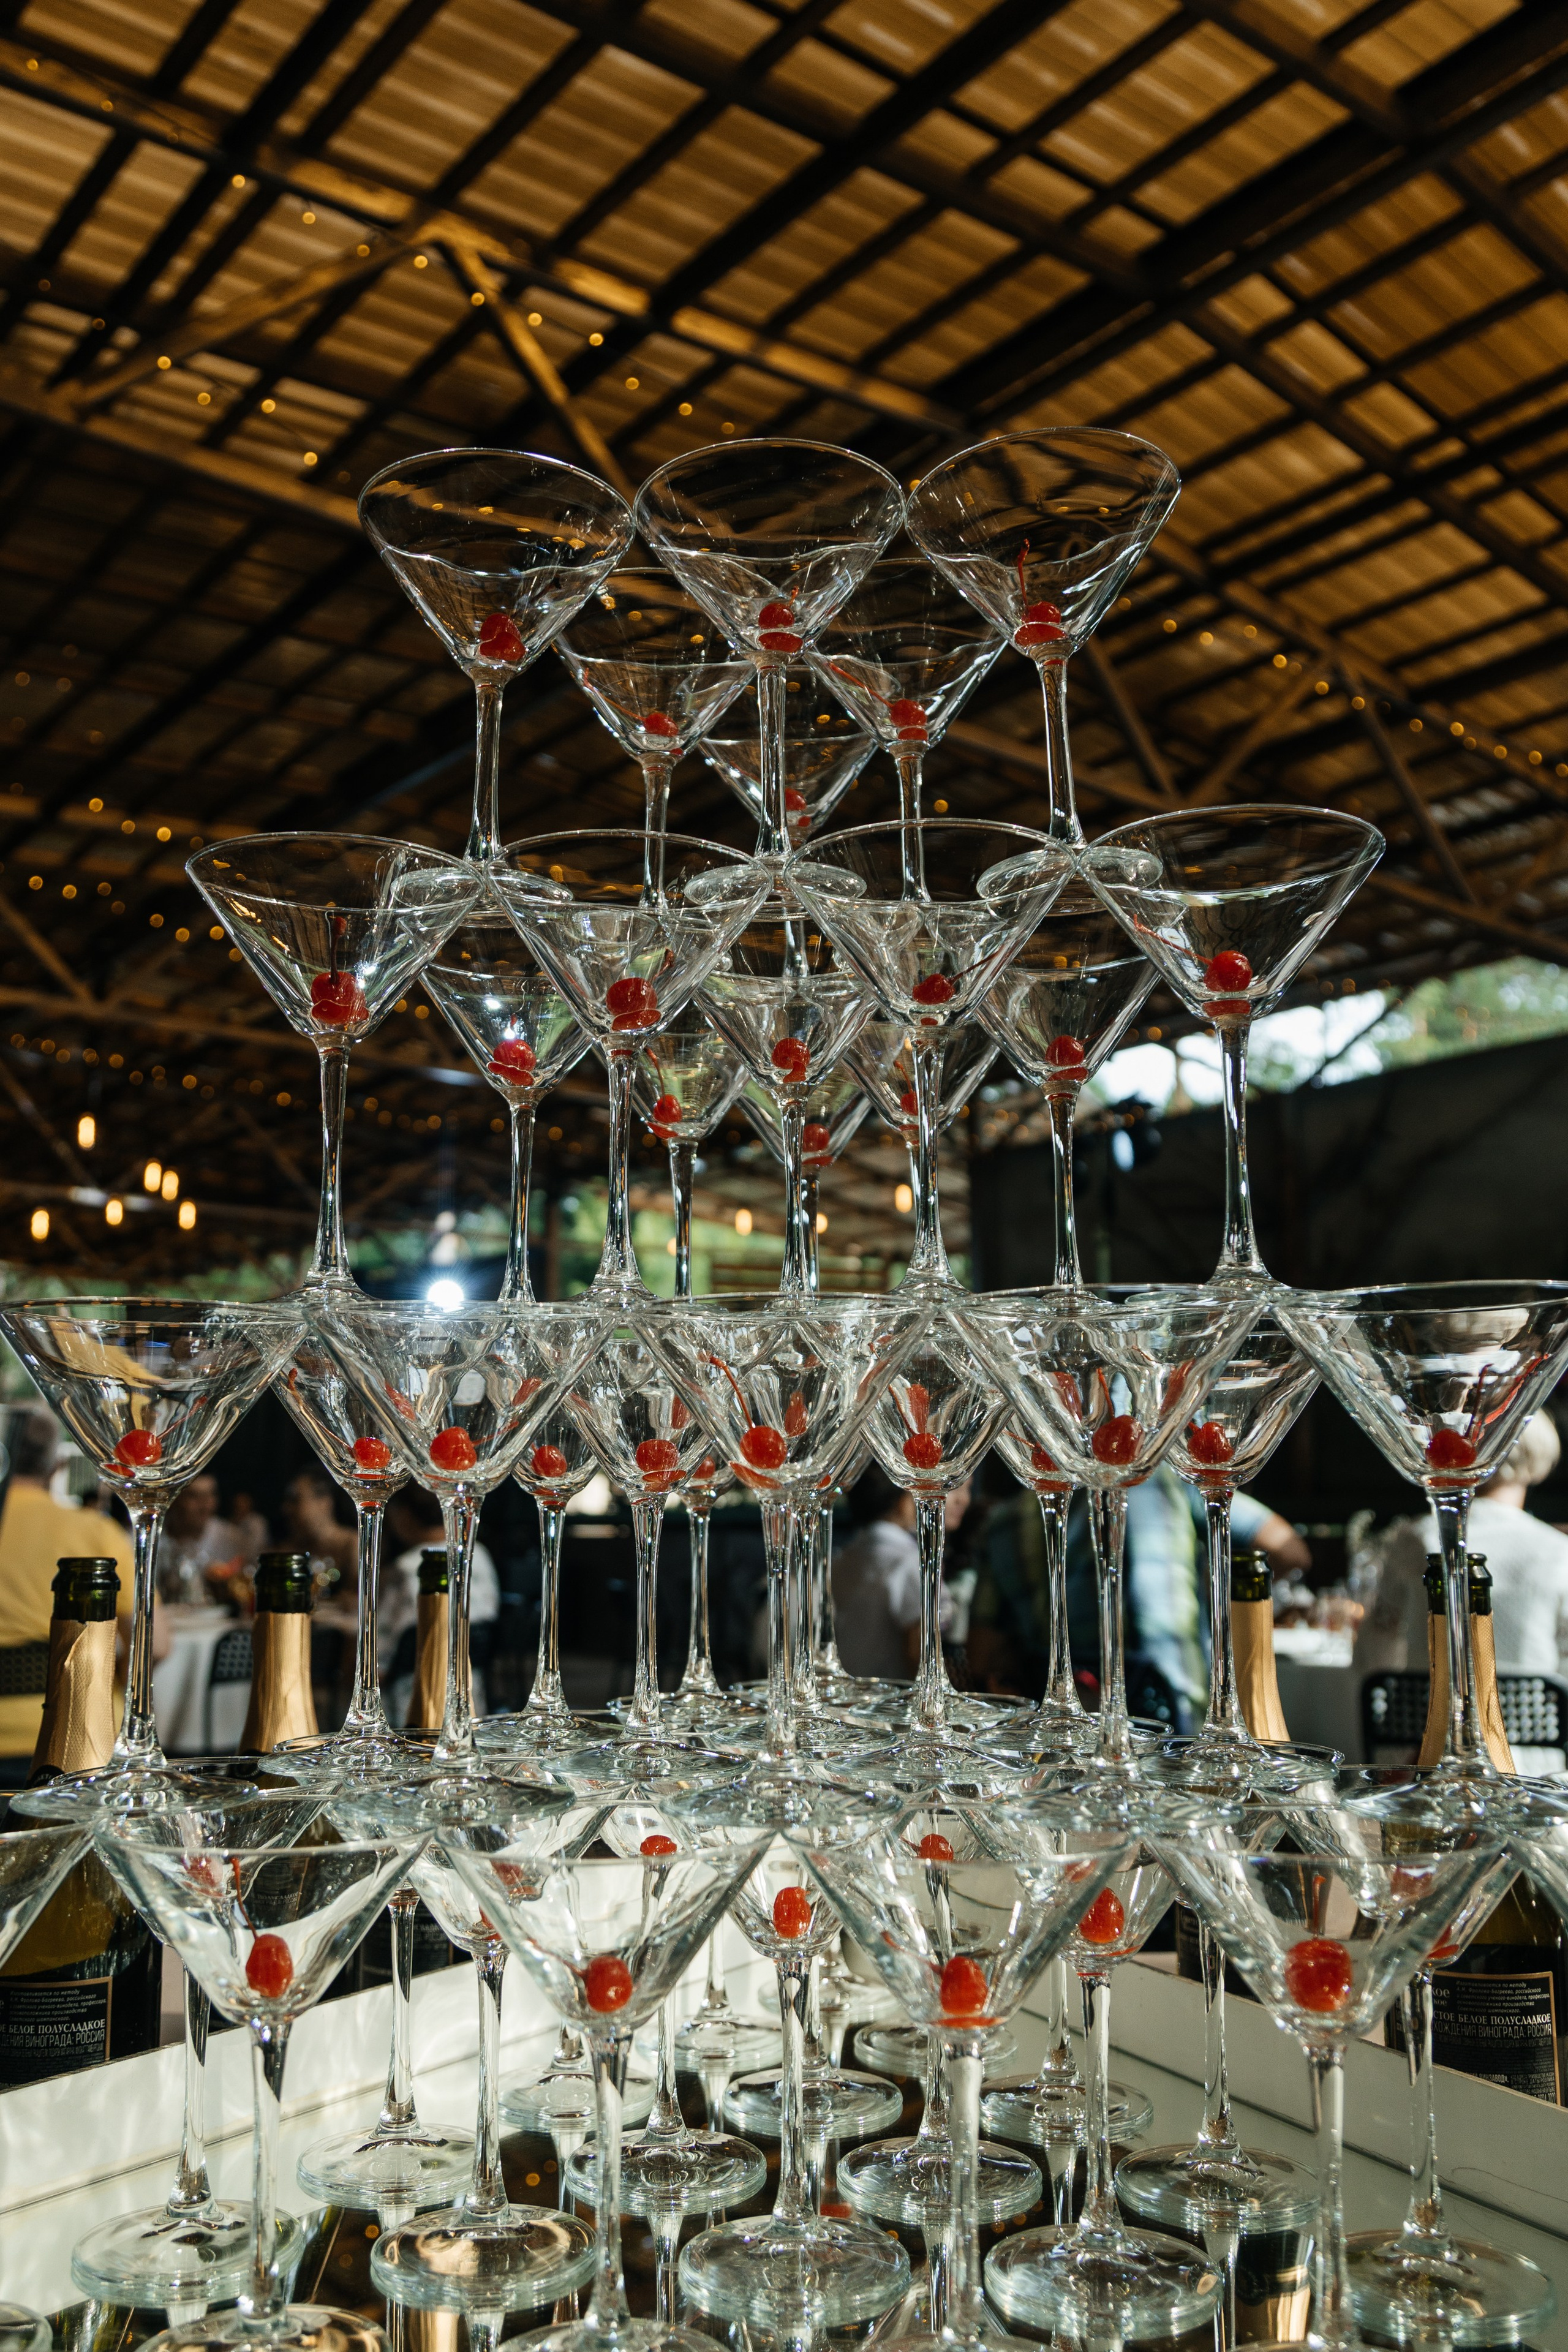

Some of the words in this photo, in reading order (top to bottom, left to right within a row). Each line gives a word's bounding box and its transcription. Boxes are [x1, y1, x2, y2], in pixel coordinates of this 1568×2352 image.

[67, 1993, 97, 2002] российского
[9, 2024, 35, 2034] БЕЛОЕ
[38, 2018, 106, 2034] ПОЛУСЛАДКОЕ
[1458, 2014, 1487, 2024] БЕЛОЕ
[1491, 2013, 1551, 2026] ПОЛУСЛАДКОЕ
[25, 2034, 74, 2048] ВИНОГРАДА:
[76, 2029, 105, 2045] РОССИЯ
[1478, 2024, 1526, 2039] ВИНОГРАДА:
[1527, 2023, 1552, 2038] РОССИЯ
